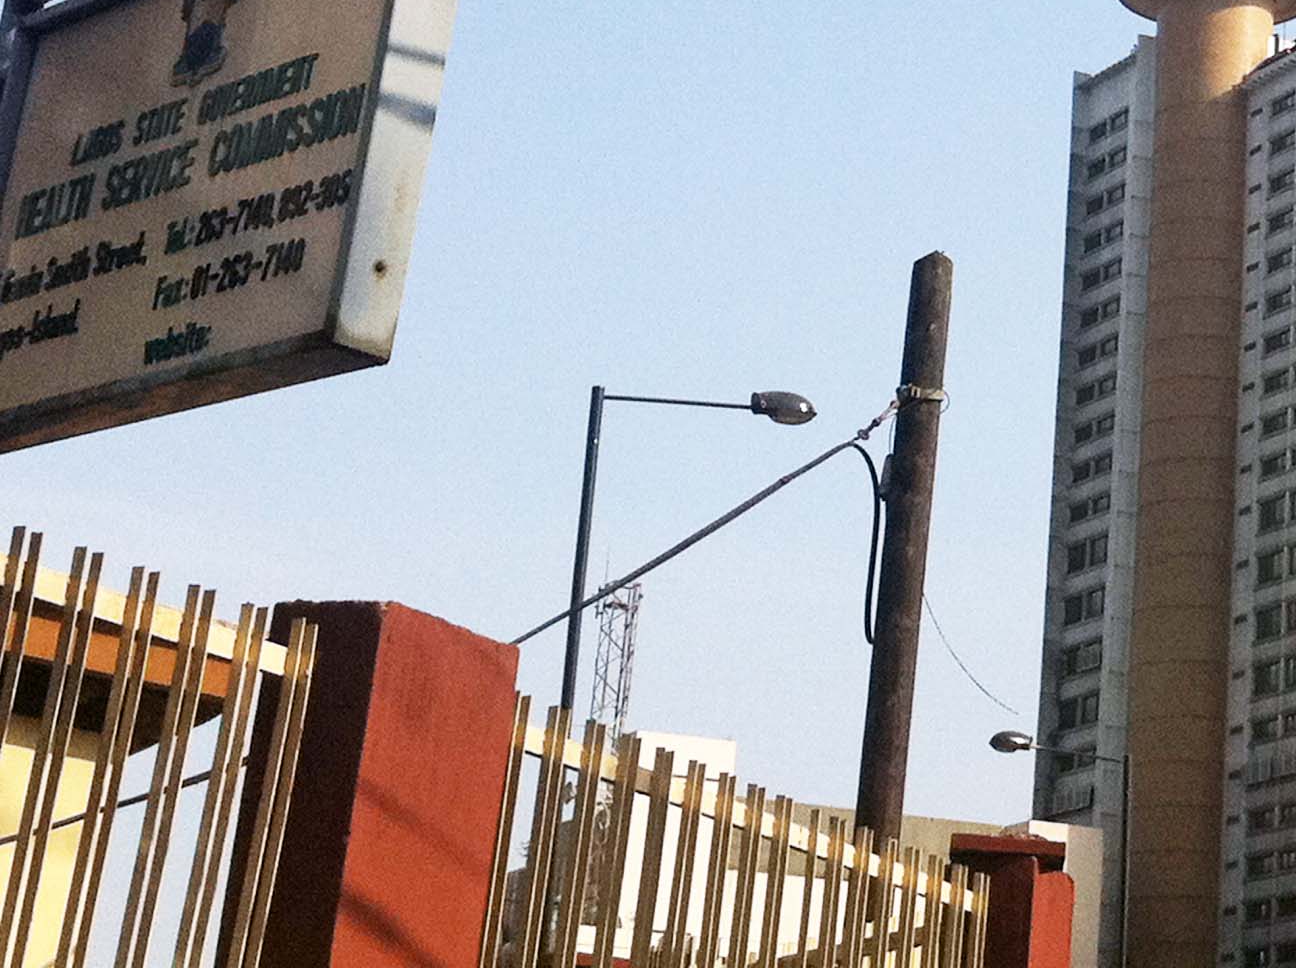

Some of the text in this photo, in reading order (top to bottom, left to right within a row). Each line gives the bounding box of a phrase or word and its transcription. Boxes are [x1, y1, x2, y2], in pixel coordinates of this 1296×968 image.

[14, 82, 366, 241] HEALTH SERVICE COMMISSION
[70, 52, 320, 166] LAGOS STATE GOVERNMENT
